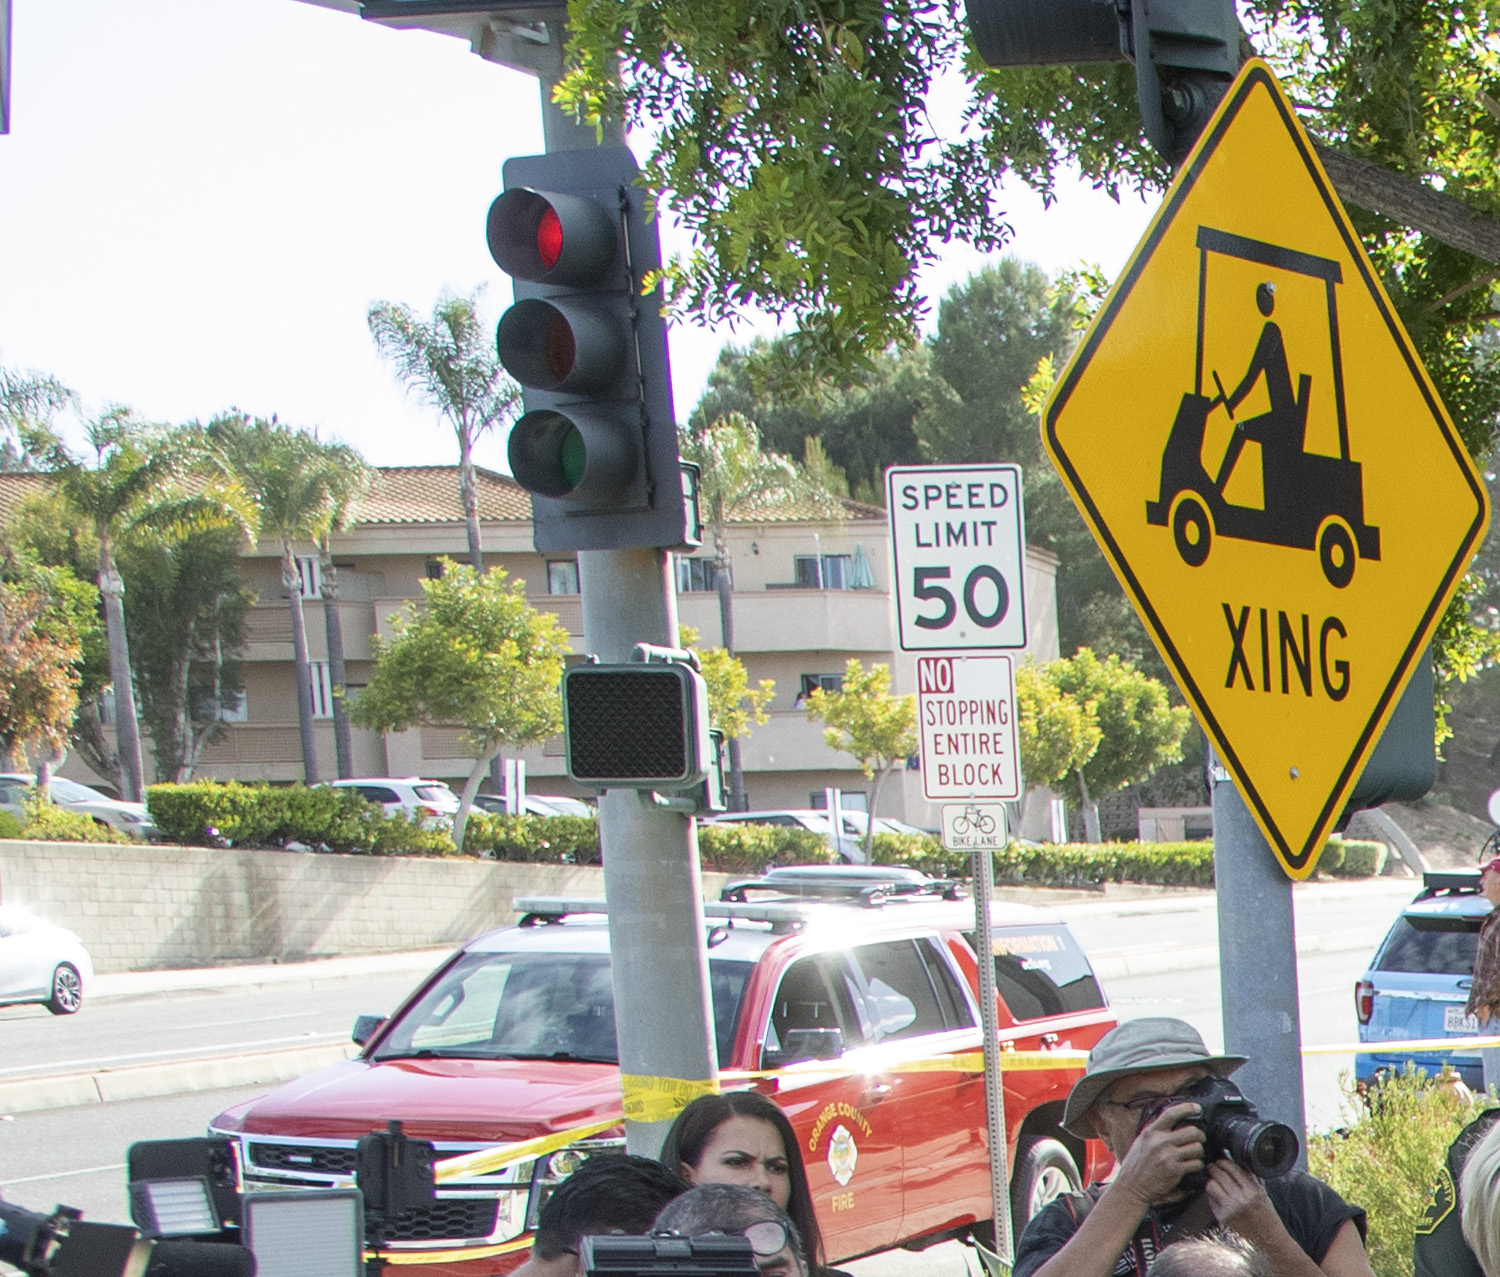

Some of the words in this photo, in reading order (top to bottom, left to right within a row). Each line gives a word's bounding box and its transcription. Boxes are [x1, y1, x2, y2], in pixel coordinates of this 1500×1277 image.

[902, 483, 1008, 511] SPEED
[915, 521, 997, 548] LIMIT
[913, 564, 1009, 630] 50
[1222, 602, 1350, 702] XING
[921, 660, 950, 692] NO
[927, 700, 1008, 726] STOPPING
[934, 733, 1004, 755] ENTIRE
[938, 763, 1003, 786] BLOCK
[952, 836, 972, 847] BIKE
[974, 836, 997, 847] LANE
[809, 1102, 838, 1152] ORANGE
[838, 1101, 873, 1138] COUNTY
[831, 1192, 854, 1212] FIRE
